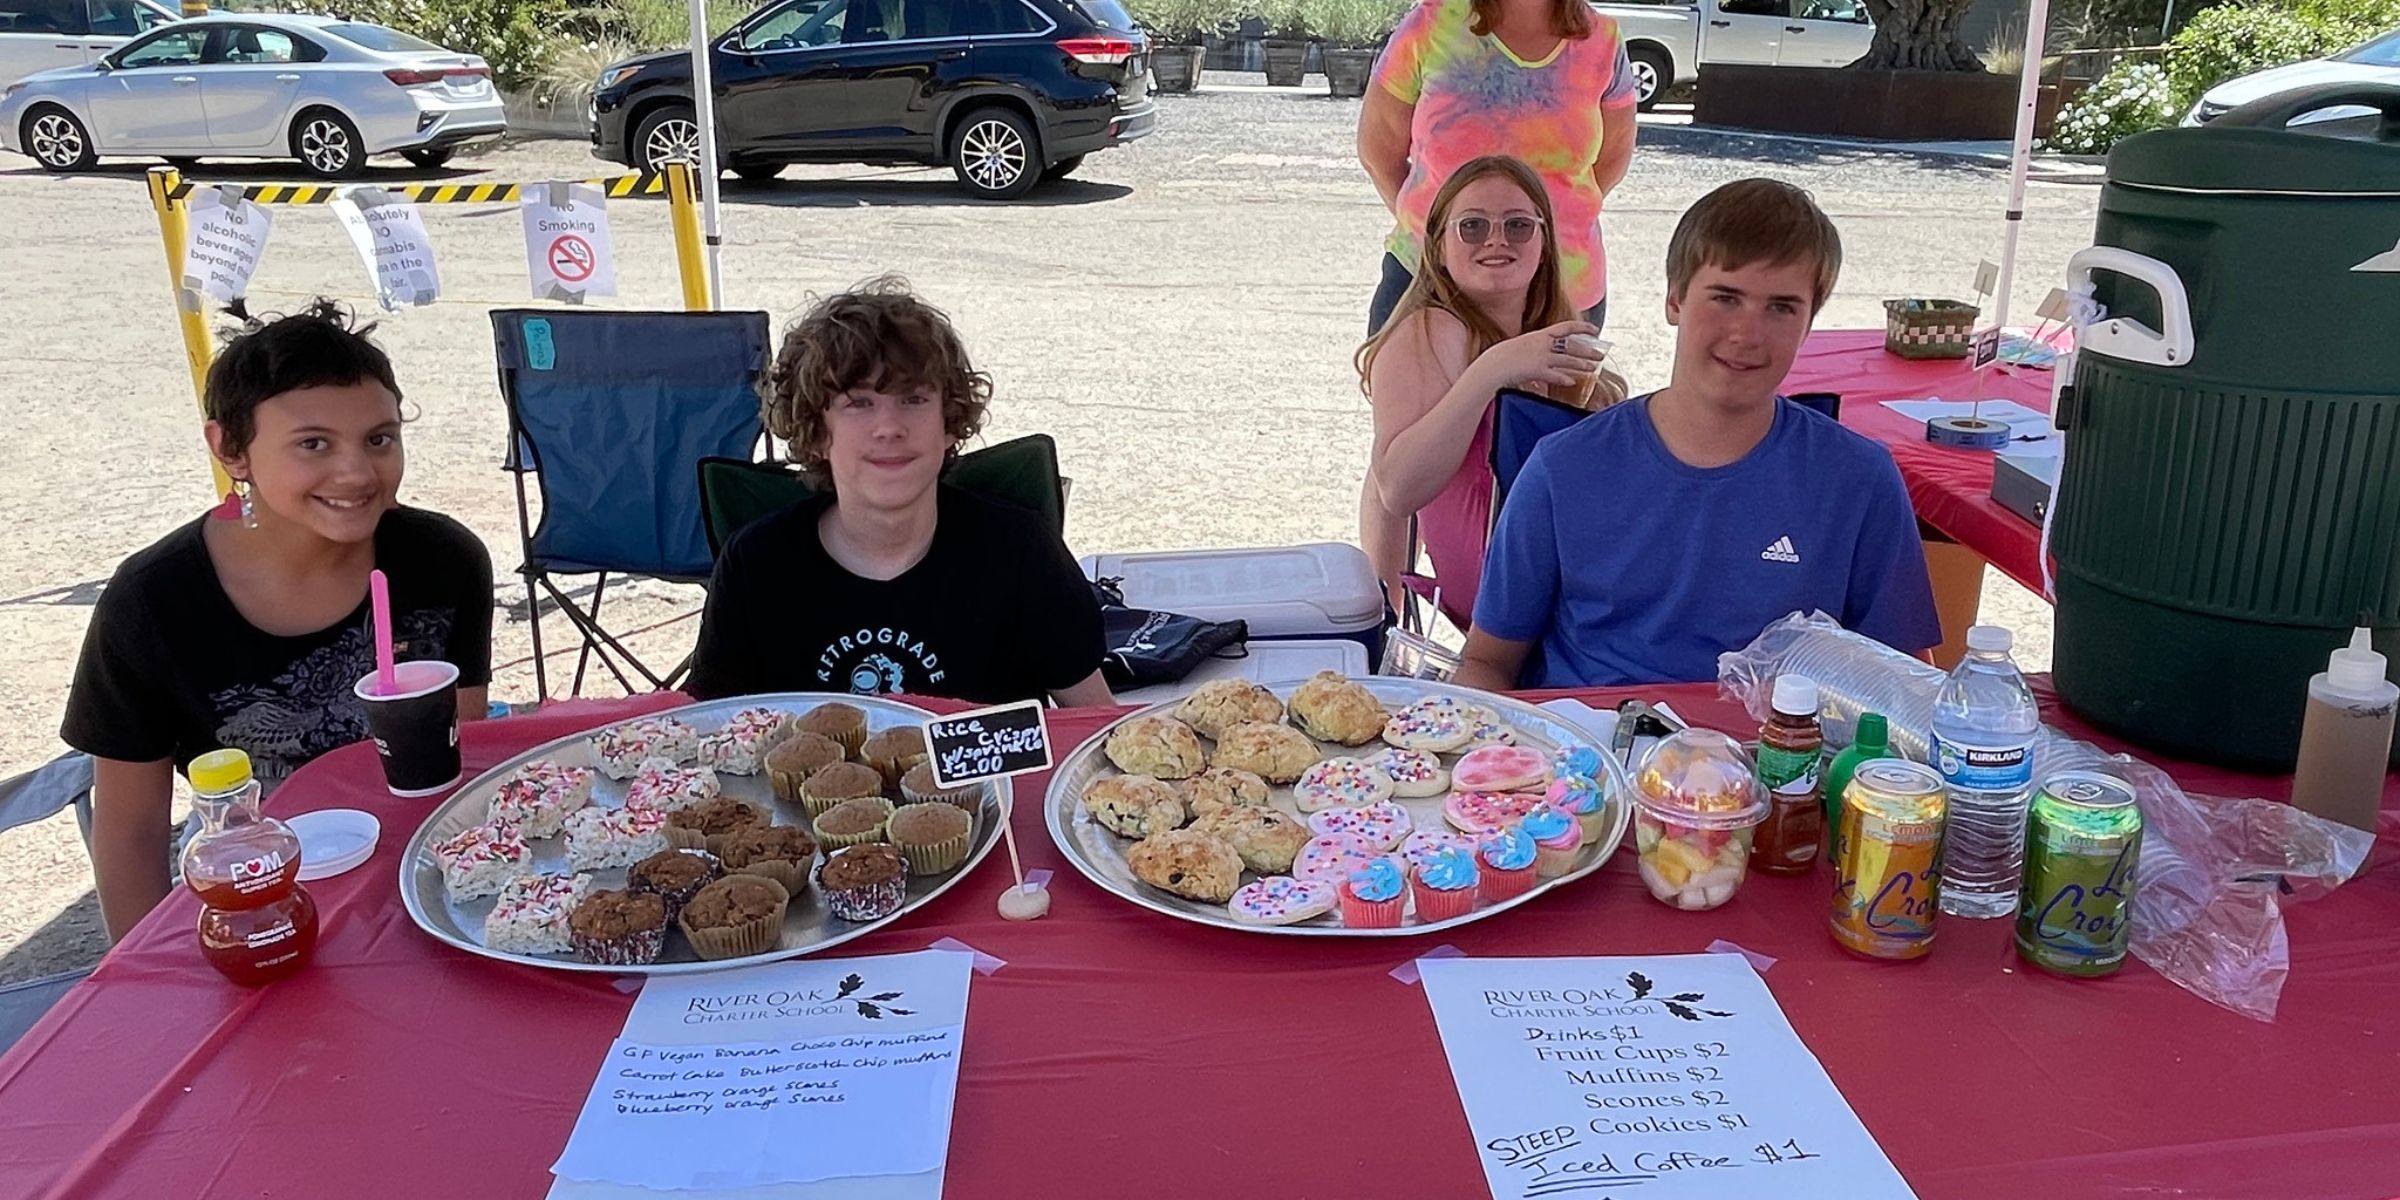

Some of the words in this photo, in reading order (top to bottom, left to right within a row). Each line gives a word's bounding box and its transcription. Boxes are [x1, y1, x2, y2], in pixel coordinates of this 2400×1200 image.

[224, 210, 243, 225] No
[538, 219, 596, 234] Smoking
[190, 249, 238, 272] beyond
[401, 258, 423, 270] the
[1761, 551, 1800, 563] adidas
[816, 627, 946, 684] RETROGRADE
[931, 720, 985, 739] Rice
[1968, 750, 2023, 762] KIRKLAND
[942, 756, 1003, 778] $1.00
[230, 850, 285, 882] POM
[687, 993, 760, 1013] RIVER
[766, 988, 824, 1007] OAK
[1483, 989, 1559, 1008] RIVER
[1562, 987, 1624, 1005] OAK
[683, 1009, 769, 1025] CHARTER
[774, 1005, 846, 1019] SCHOOL
[1491, 1006, 1580, 1019] CHARTER
[1583, 1004, 1660, 1017] SCHOOL
[659, 1051, 704, 1065] Vegan
[1535, 1046, 1609, 1062] Fruit
[1614, 1045, 1688, 1064] Cups
[1693, 1042, 1731, 1060] $2
[619, 1068, 678, 1081] Carrot
[682, 1069, 725, 1081] Cake
[1564, 1067, 1681, 1086] Muffins
[1686, 1066, 1724, 1084] $2
[613, 1089, 714, 1103] Strawberry
[1583, 1092, 1686, 1109] Scones
[1691, 1089, 1730, 1108] $2
[1589, 1116, 1712, 1135] Cookies
[1716, 1113, 1752, 1132] $1
[1486, 1125, 1576, 1162] STEEP
[1521, 1152, 1623, 1182] Iced
[1633, 1151, 1745, 1173] Coffee
[1750, 1137, 1822, 1165] $1
